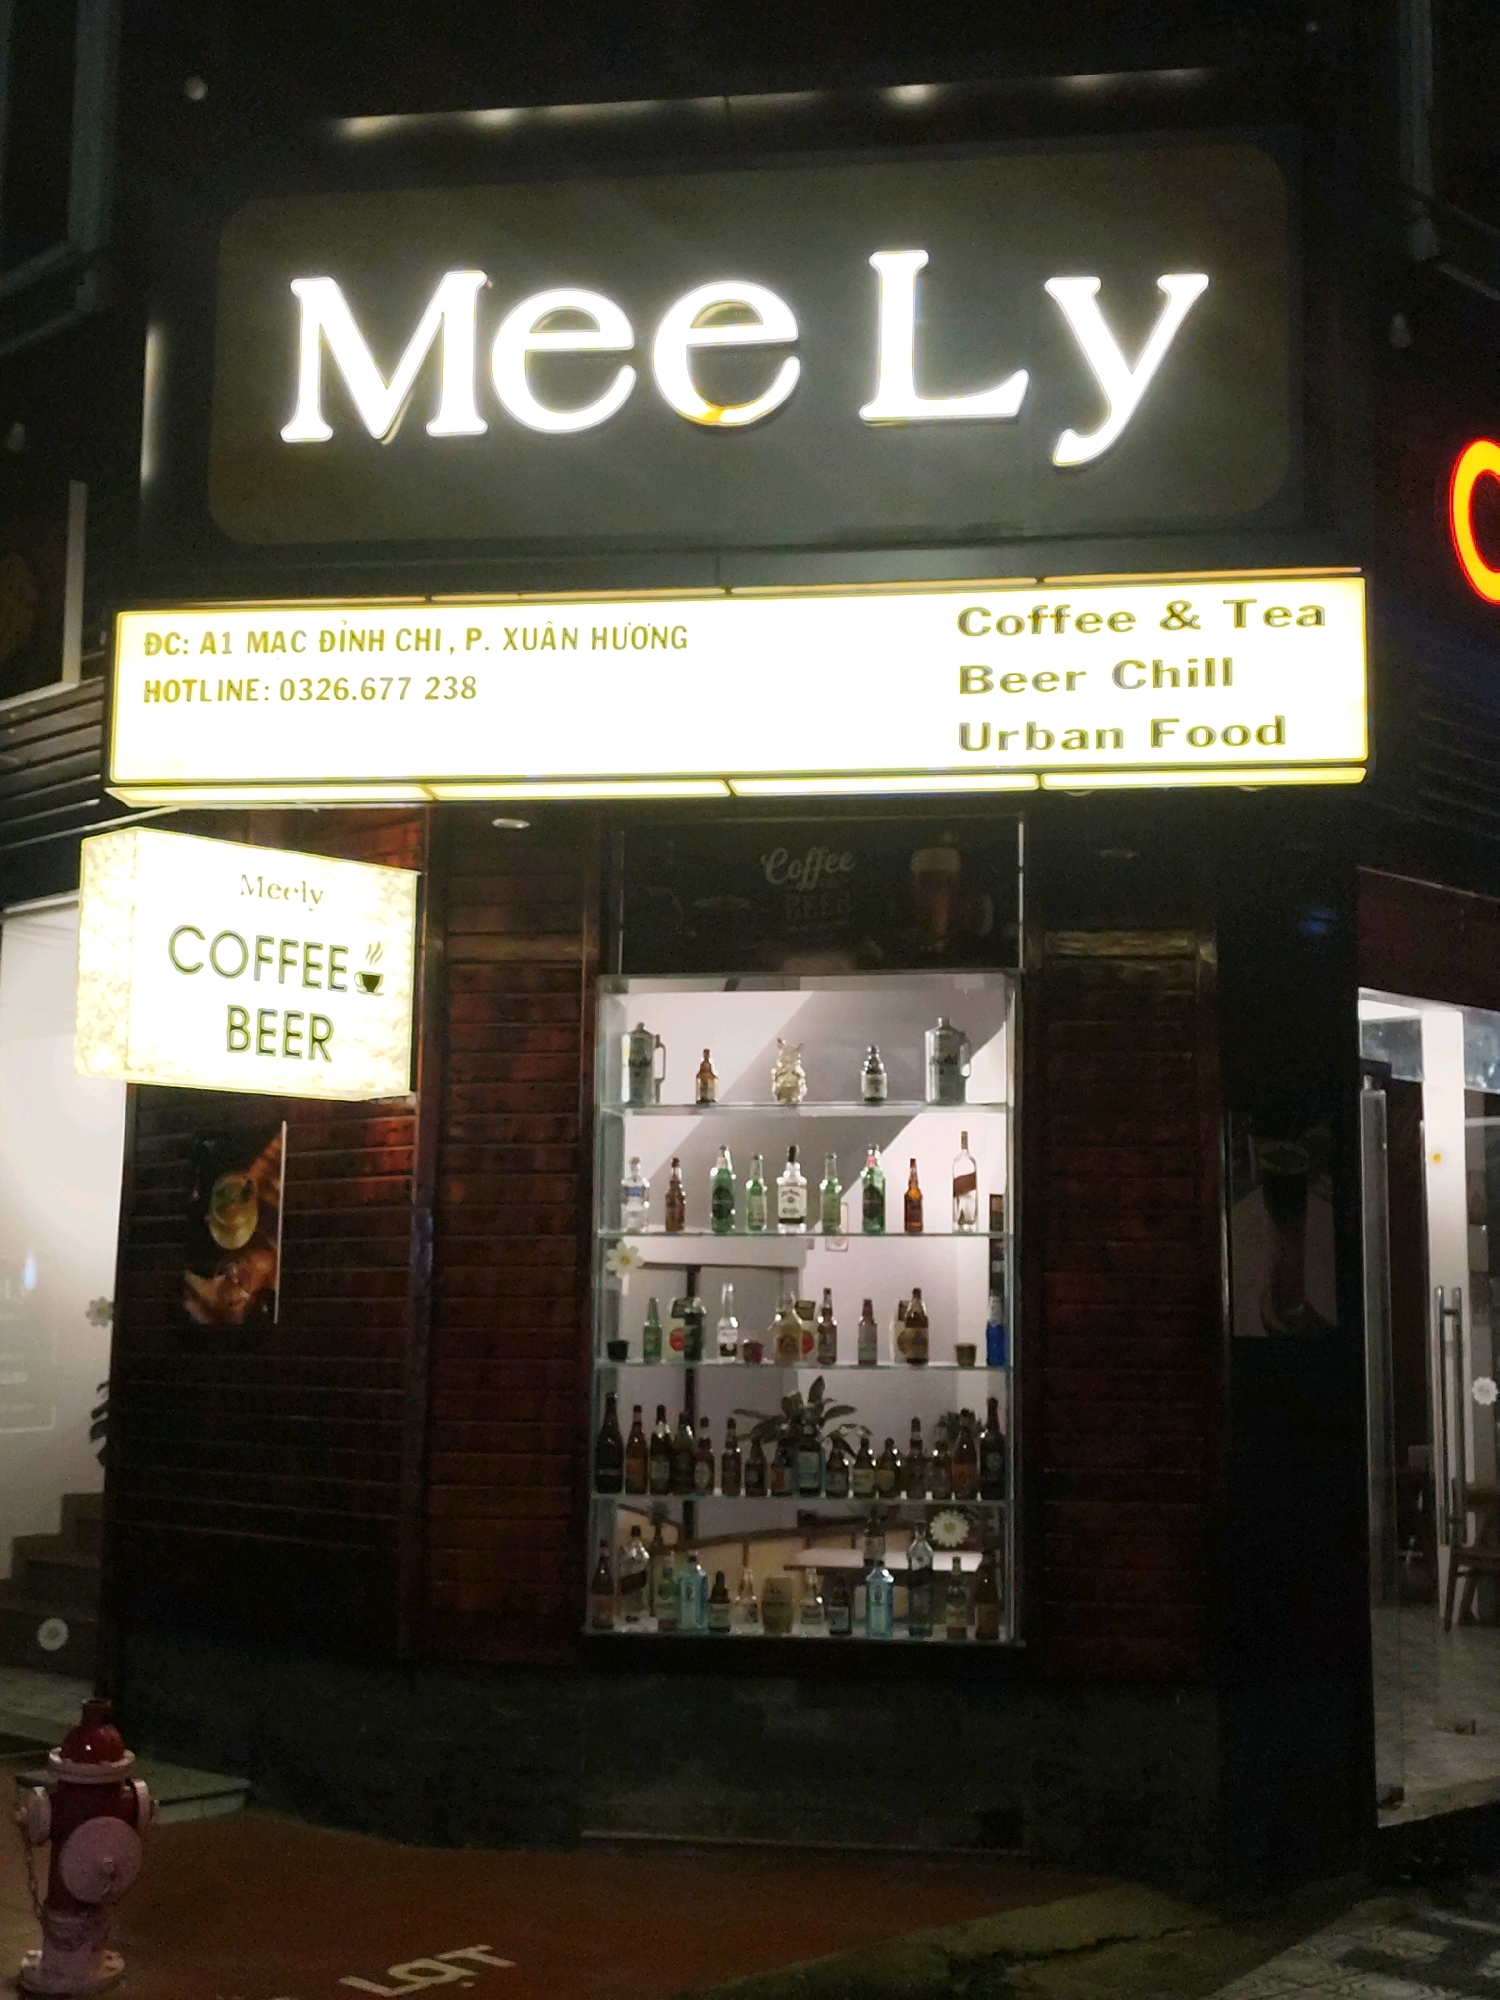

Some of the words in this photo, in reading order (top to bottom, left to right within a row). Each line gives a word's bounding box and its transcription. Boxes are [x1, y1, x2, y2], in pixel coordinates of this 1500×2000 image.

[281, 270, 800, 444] Mee
[859, 249, 1210, 468] Ly
[956, 603, 1137, 637] Coffee
[1158, 599, 1202, 632] &
[1222, 598, 1326, 630] Tea
[142, 629, 190, 658] ĐC:
[199, 630, 233, 656] A1
[464, 626, 490, 652] P.
[502, 620, 579, 652] XUÂN
[590, 621, 688, 651] HƯƠNG
[142, 677, 270, 705] HOTLINE:
[279, 676, 412, 703] 0326.677
[424, 675, 477, 701] 238
[959, 664, 1087, 695] Beer
[1111, 656, 1233, 690] Chill
[958, 721, 1124, 752] Urban
[1149, 714, 1286, 749] Food
[759, 846, 857, 892] Coffee
[240, 874, 324, 912] Meely
[168, 924, 349, 993] COFFEE
[226, 1004, 335, 1063] BEER
